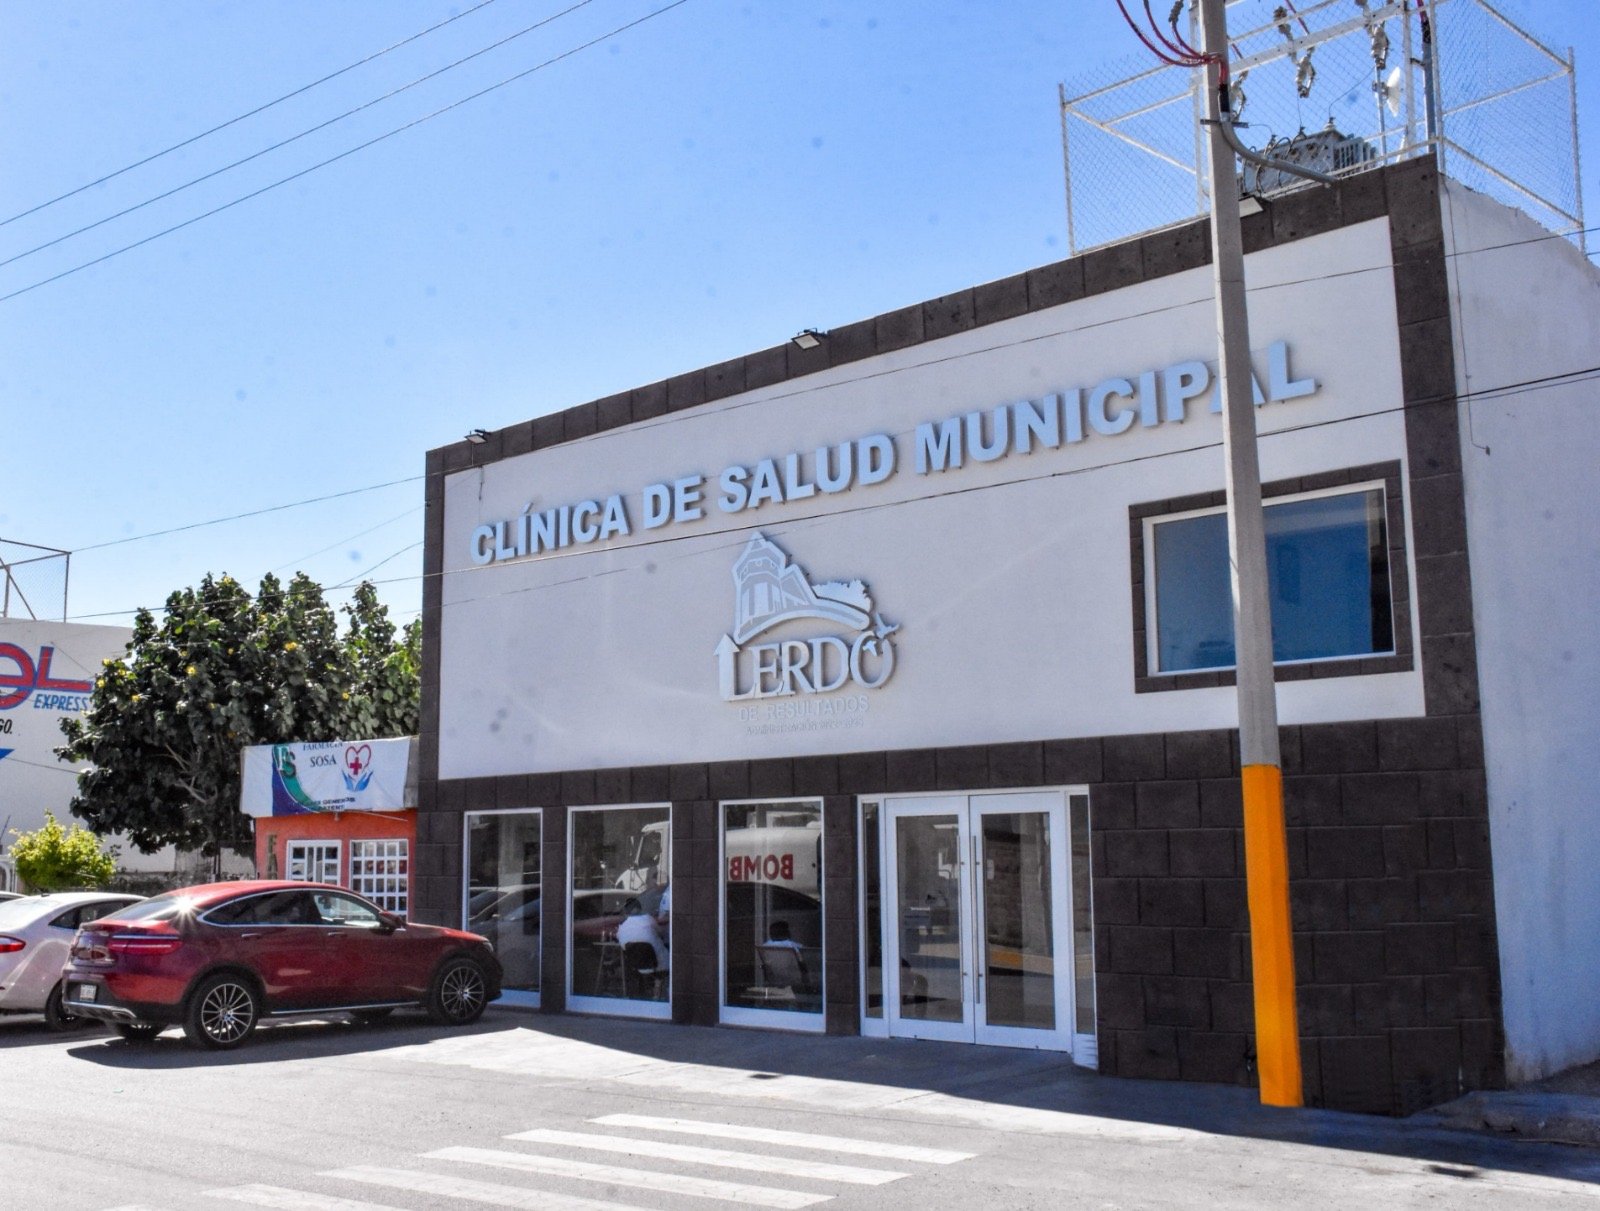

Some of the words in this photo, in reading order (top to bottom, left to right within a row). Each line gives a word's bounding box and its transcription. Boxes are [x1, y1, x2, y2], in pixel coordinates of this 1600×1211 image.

[470, 493, 631, 566] CLÍNICA
[643, 475, 704, 530] DE
[717, 433, 898, 514] SALUD
[914, 340, 1318, 475] MUNICIPL
[714, 632, 893, 702] LERDO
[34, 693, 89, 712] EXPRESS
[739, 706, 758, 722] DE
[767, 695, 870, 719] RESULTADOS
[310, 754, 337, 768] SOSA
